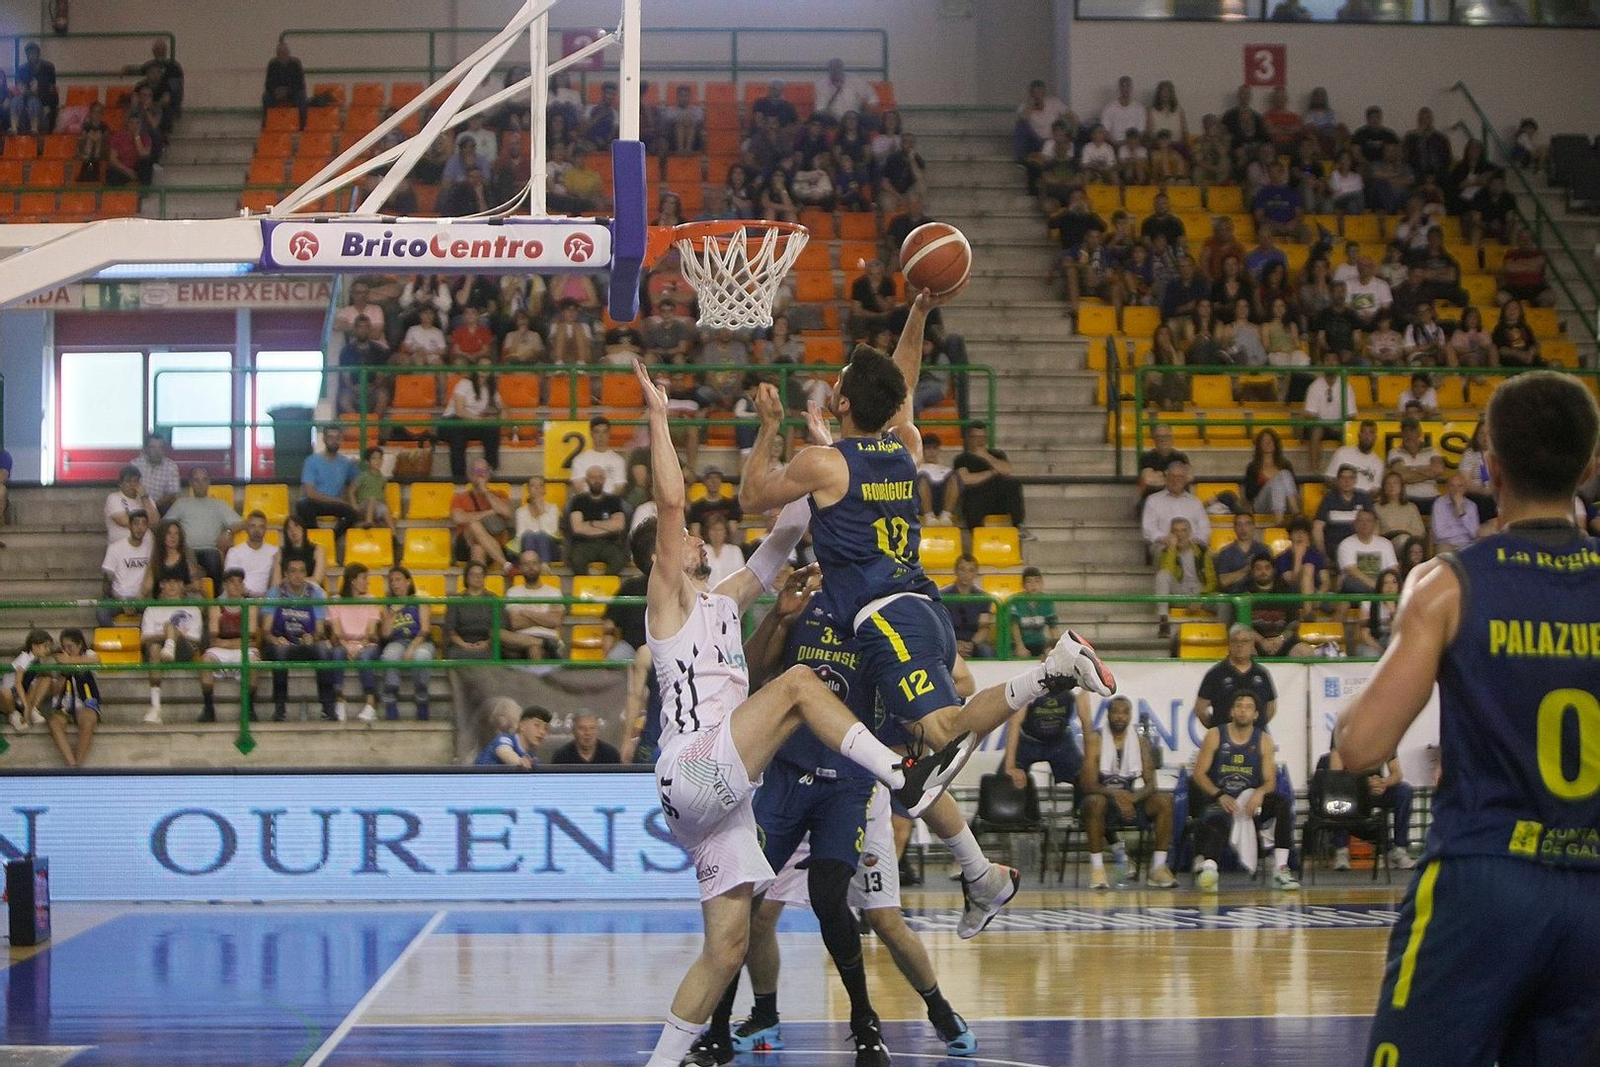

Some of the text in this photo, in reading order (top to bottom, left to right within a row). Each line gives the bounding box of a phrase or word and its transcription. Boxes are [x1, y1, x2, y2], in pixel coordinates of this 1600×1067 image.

[1254, 49, 1275, 80] 3
[341, 230, 544, 259] BricoCentro
[177, 282, 331, 302] EMERXENCIA
[562, 431, 585, 468] 2
[898, 668, 935, 702] 12
[1536, 687, 1600, 798] 0
[862, 871, 883, 893] 13
